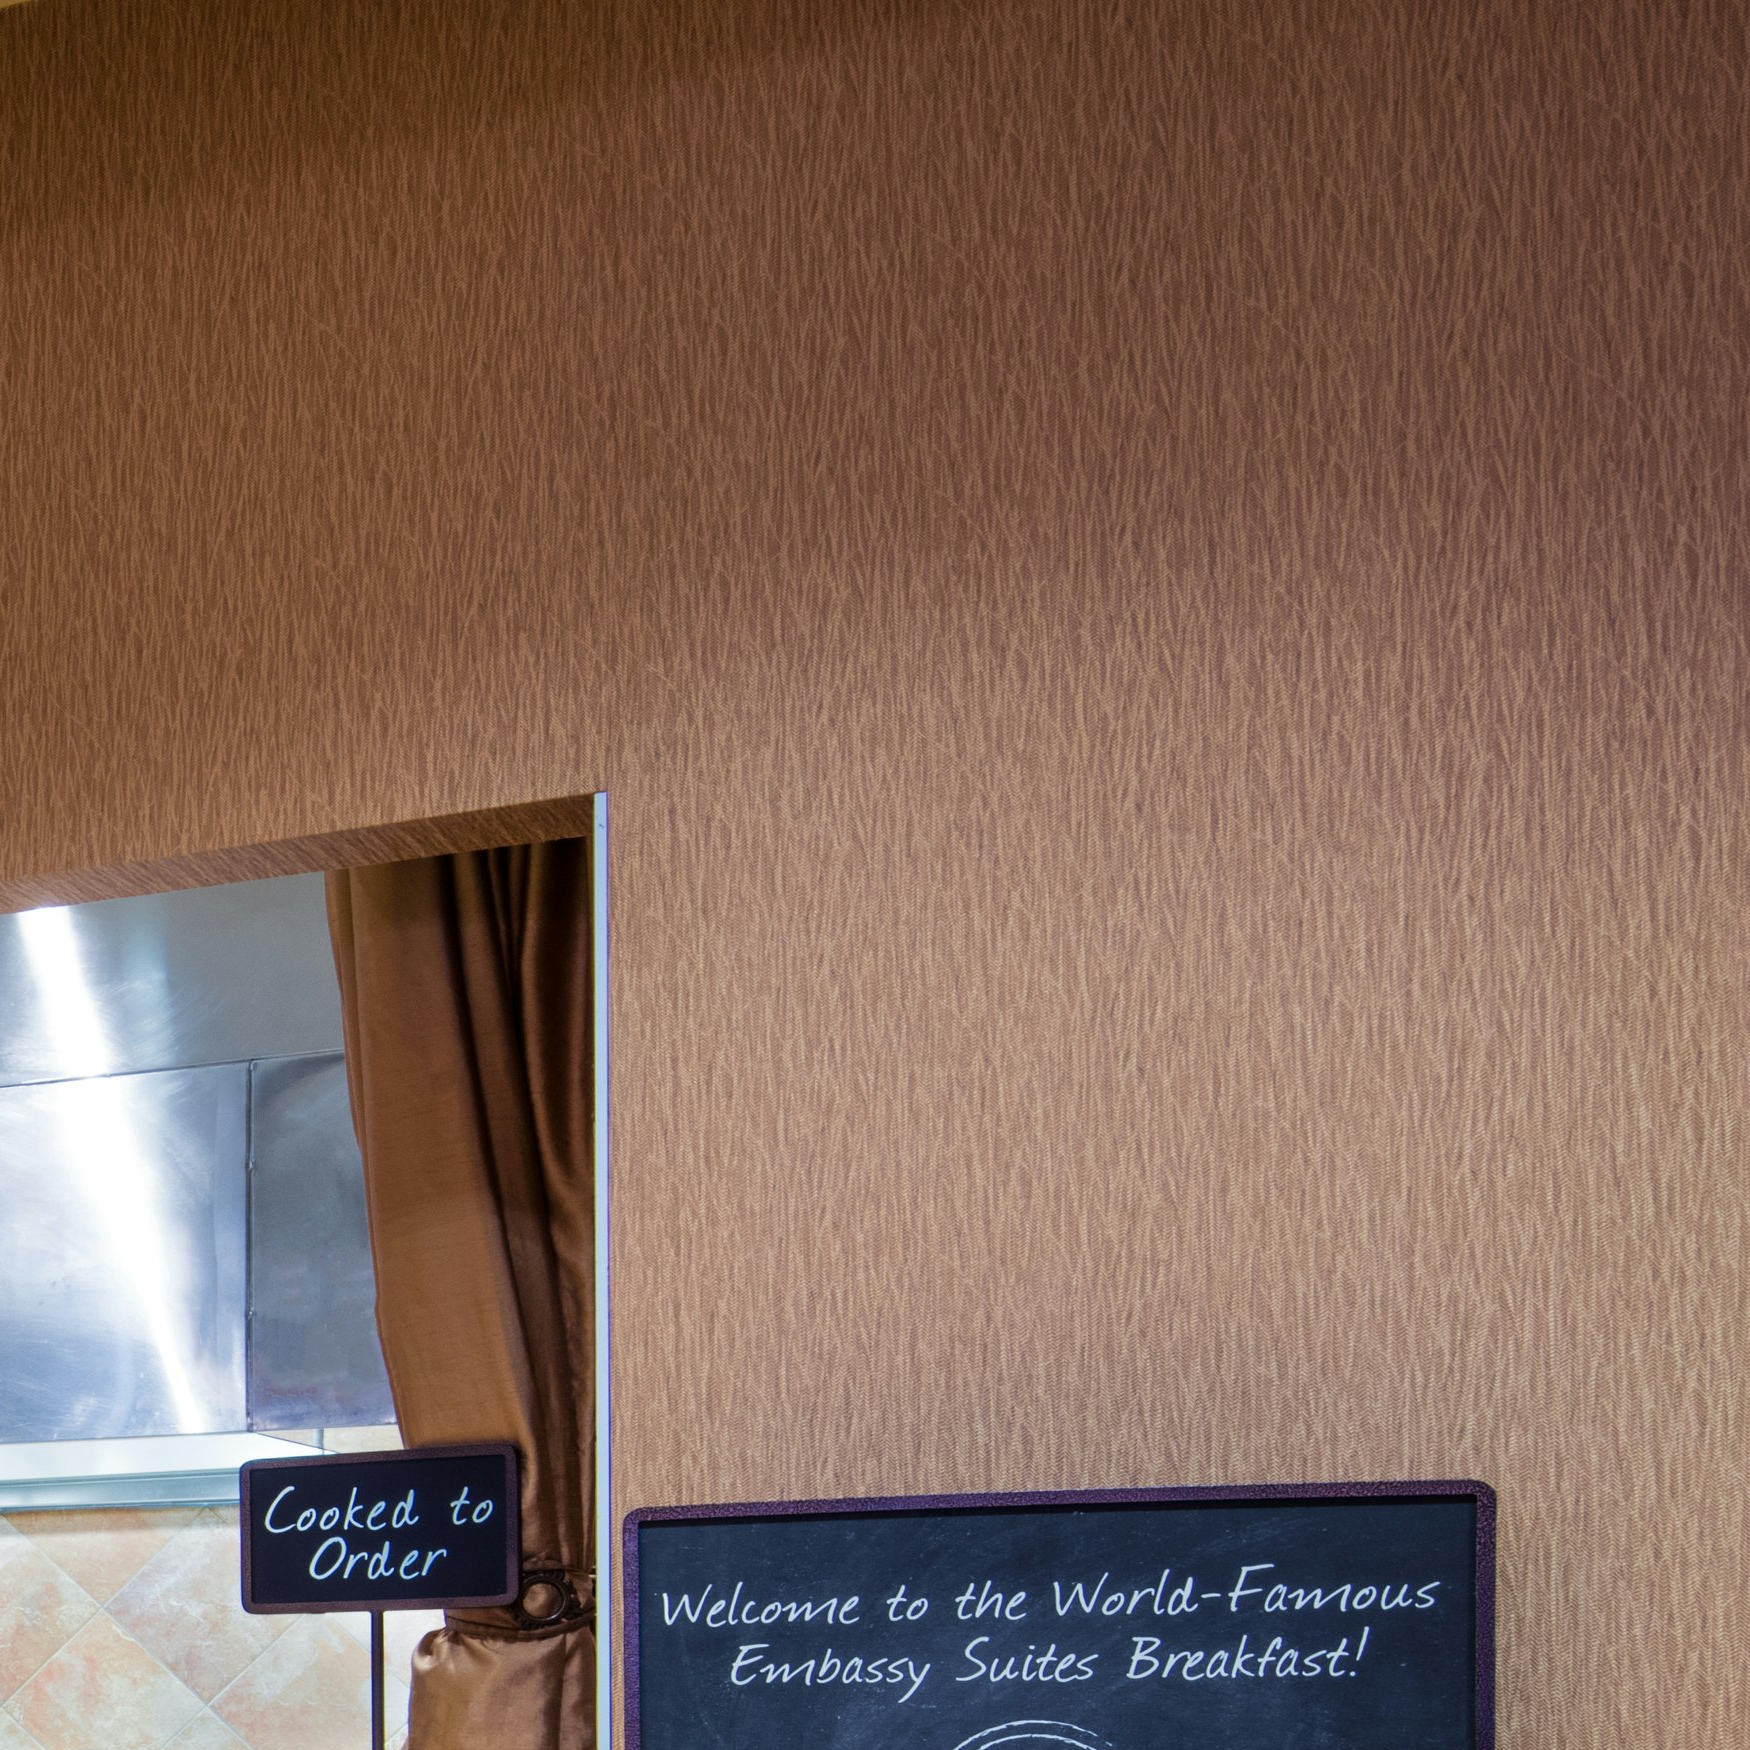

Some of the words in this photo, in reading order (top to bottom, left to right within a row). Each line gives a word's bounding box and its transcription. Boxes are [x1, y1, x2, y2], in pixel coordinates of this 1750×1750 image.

[264, 1485, 419, 1534] Cooked
[449, 1486, 493, 1526] to
[308, 1536, 447, 1580] Order
[662, 1581, 860, 1628] Welcome
[886, 1584, 929, 1622] to
[954, 1580, 1027, 1621] the
[1053, 1563, 1441, 1617] World-Famous
[730, 1643, 931, 1704] Embassy
[955, 1636, 1099, 1683] Suites
[1125, 1626, 1370, 1681] Breakfast!
